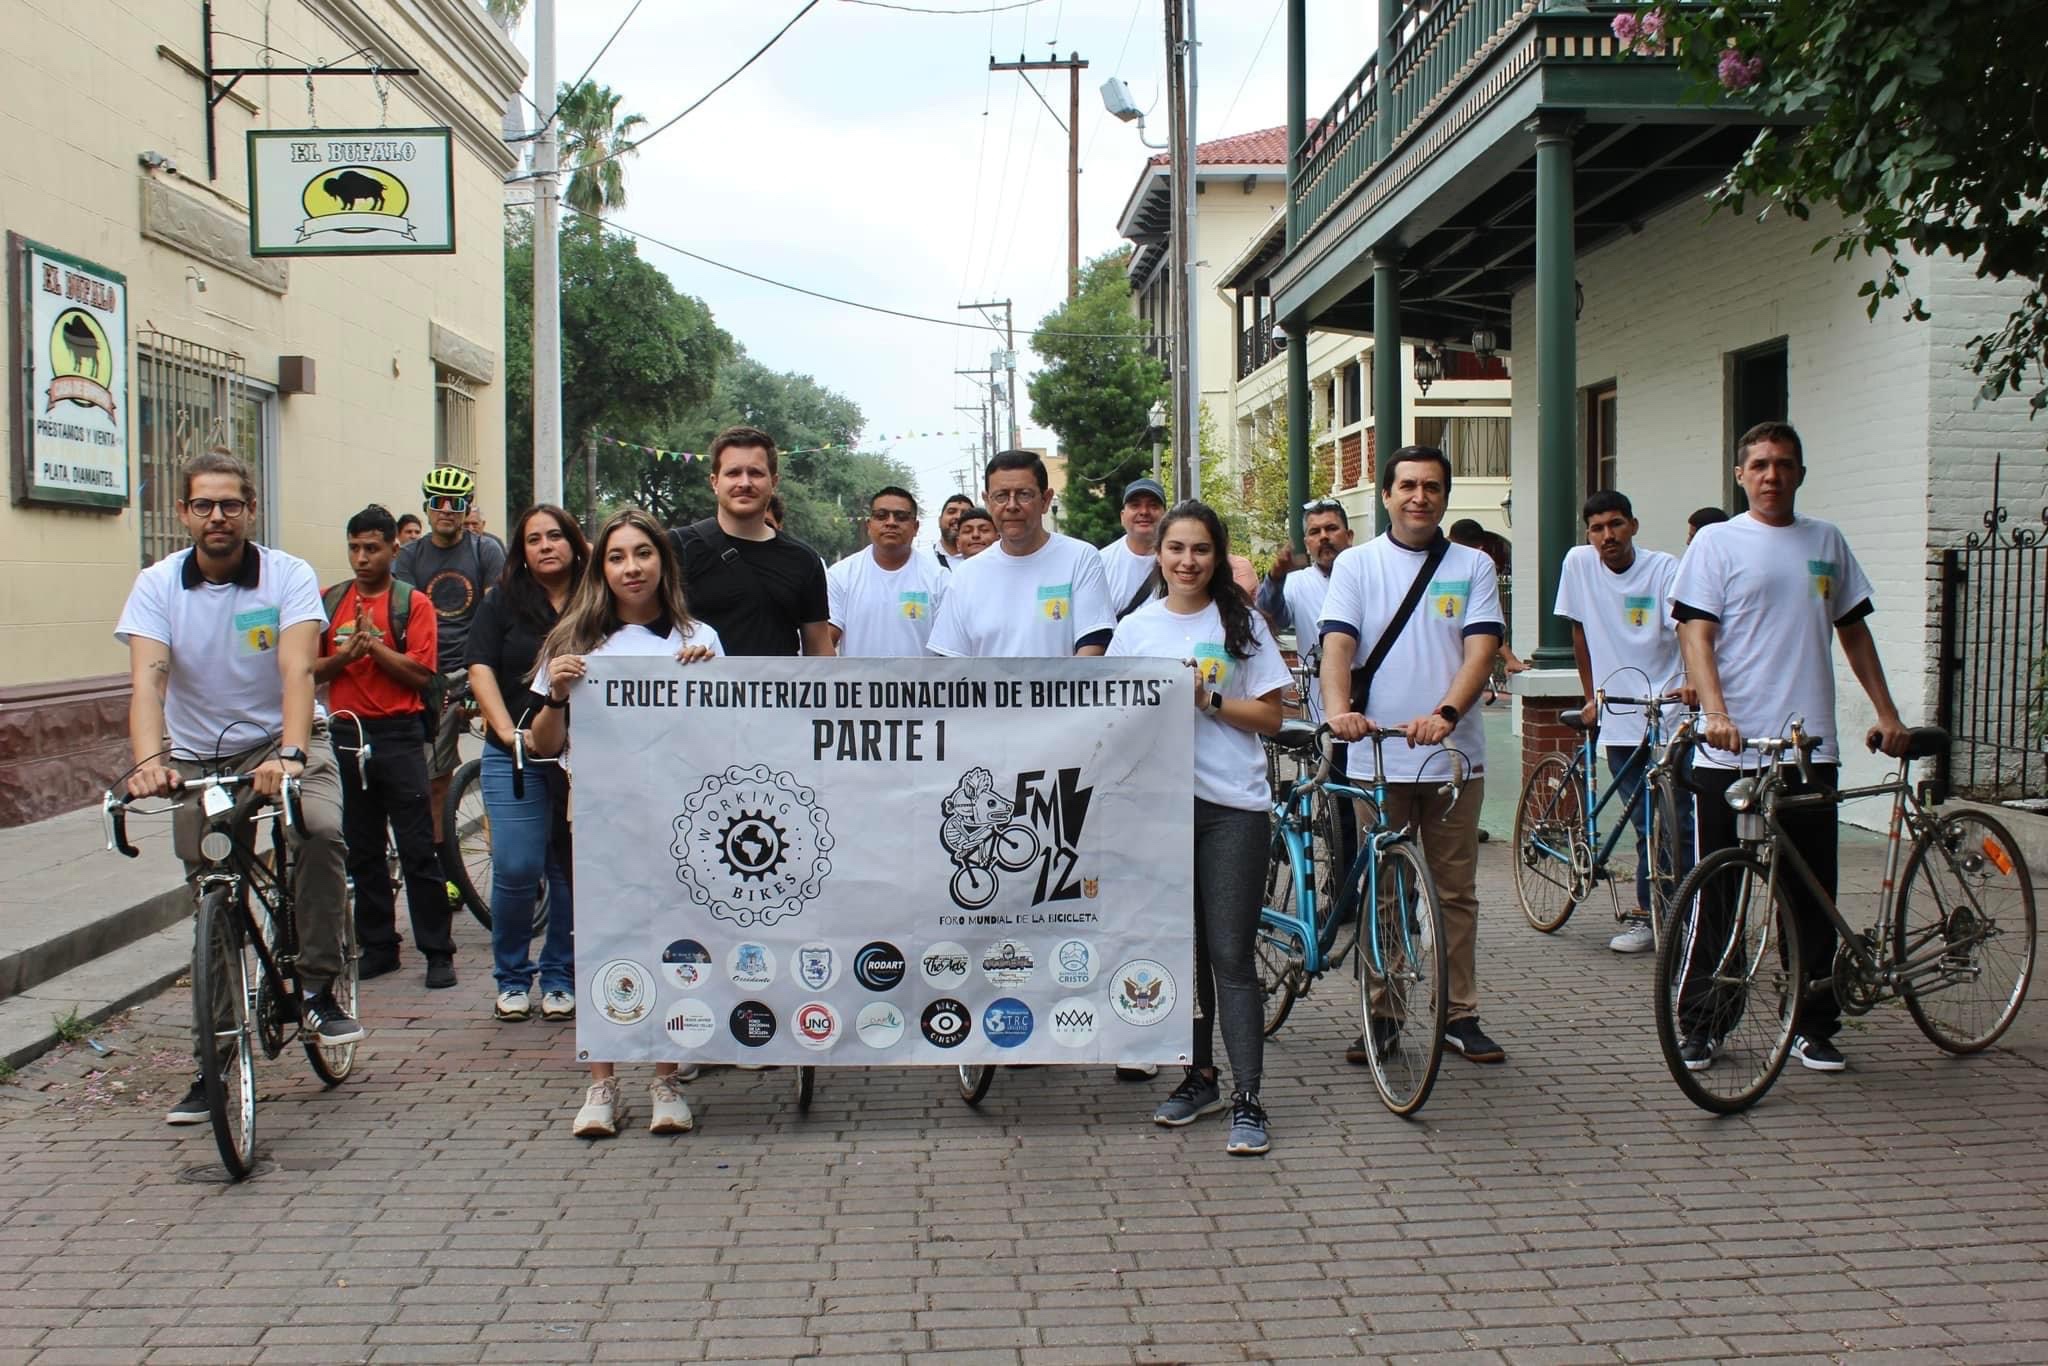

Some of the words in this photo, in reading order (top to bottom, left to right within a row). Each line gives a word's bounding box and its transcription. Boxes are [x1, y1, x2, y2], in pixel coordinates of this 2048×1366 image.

[291, 143, 321, 162] EL
[328, 141, 416, 162] BUFALO
[42, 262, 62, 296] EL
[65, 270, 116, 314] BUFALO
[86, 427, 91, 444] Y
[94, 428, 116, 447] VENTA
[686, 681, 826, 709] FRONTERIZO
[834, 682, 863, 709] DE
[869, 677, 987, 709] DONACIÓN
[995, 681, 1023, 708] DE
[812, 719, 924, 761] PARTE
[935, 720, 945, 761] 1
[698, 791, 791, 841] WORKING
[732, 873, 797, 902] BIKES
[1031, 846, 1082, 908] 12
[939, 916, 965, 925] FORO
[968, 915, 1012, 925] MUNDIAL
[1016, 914, 1029, 924] DE
[1032, 914, 1045, 923] LA
[1048, 913, 1098, 923] BICICLETA
[868, 960, 904, 970] RODART
[732, 975, 771, 983] Occidente
[1058, 975, 1089, 983] CRISTO
[930, 1032, 963, 1044] CINEMA
